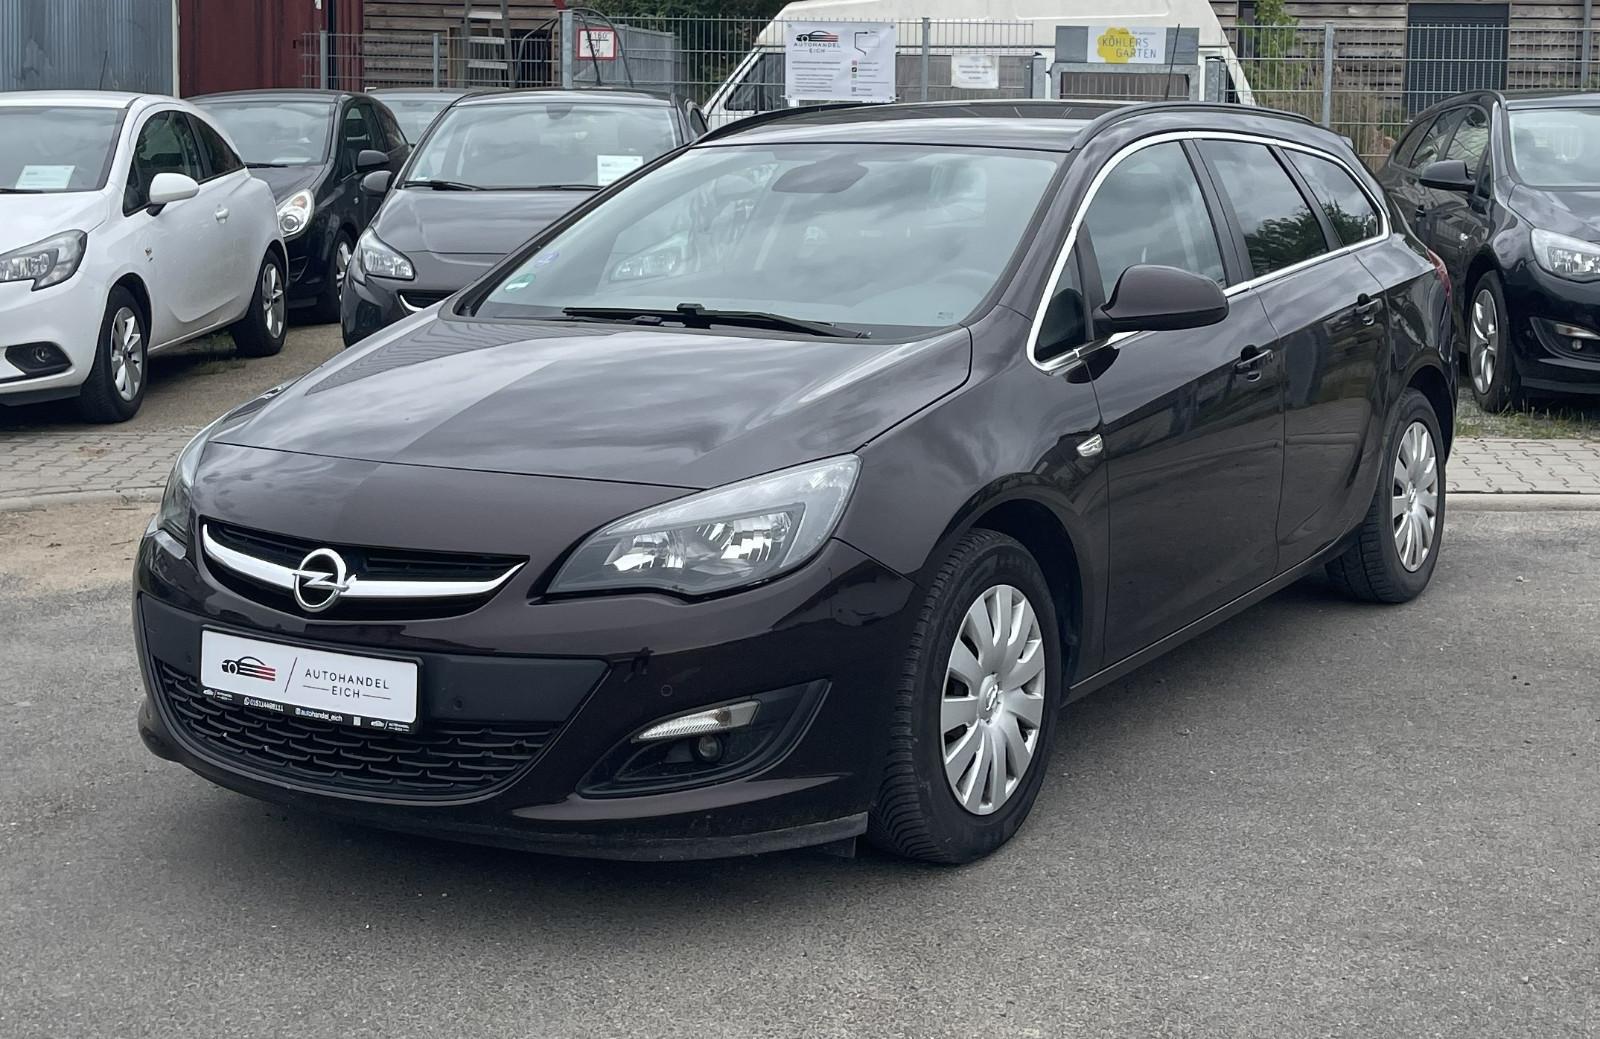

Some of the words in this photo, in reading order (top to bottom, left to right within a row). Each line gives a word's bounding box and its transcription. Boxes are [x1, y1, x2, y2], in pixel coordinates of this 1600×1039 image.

[1102, 35, 1149, 47] KÖHLERS
[1115, 48, 1157, 58] GARTEN
[304, 668, 390, 690] AUTOHANDEL
[331, 686, 361, 699] EICH
